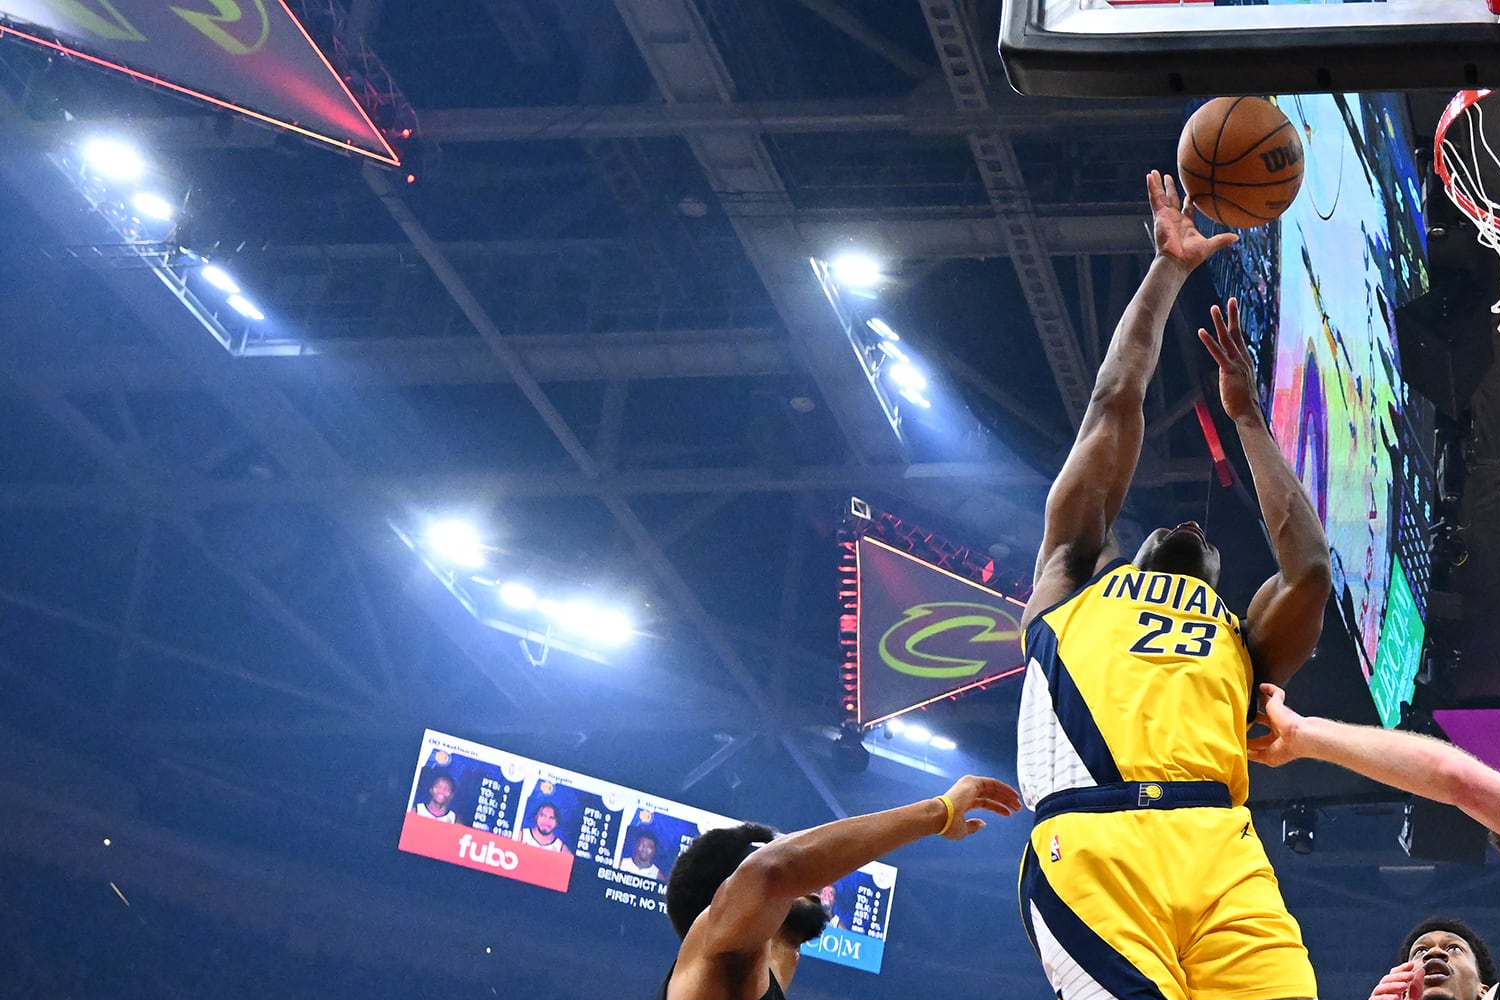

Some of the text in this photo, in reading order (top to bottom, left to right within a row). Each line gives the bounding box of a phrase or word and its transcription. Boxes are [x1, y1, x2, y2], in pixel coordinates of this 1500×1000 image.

[1102, 571, 1234, 625] INDIAN
[1129, 611, 1218, 658] 23
[458, 834, 519, 871] fubo
[597, 867, 657, 892] BENNEDICT
[605, 888, 637, 907] FIRST,
[639, 897, 656, 911] NO
